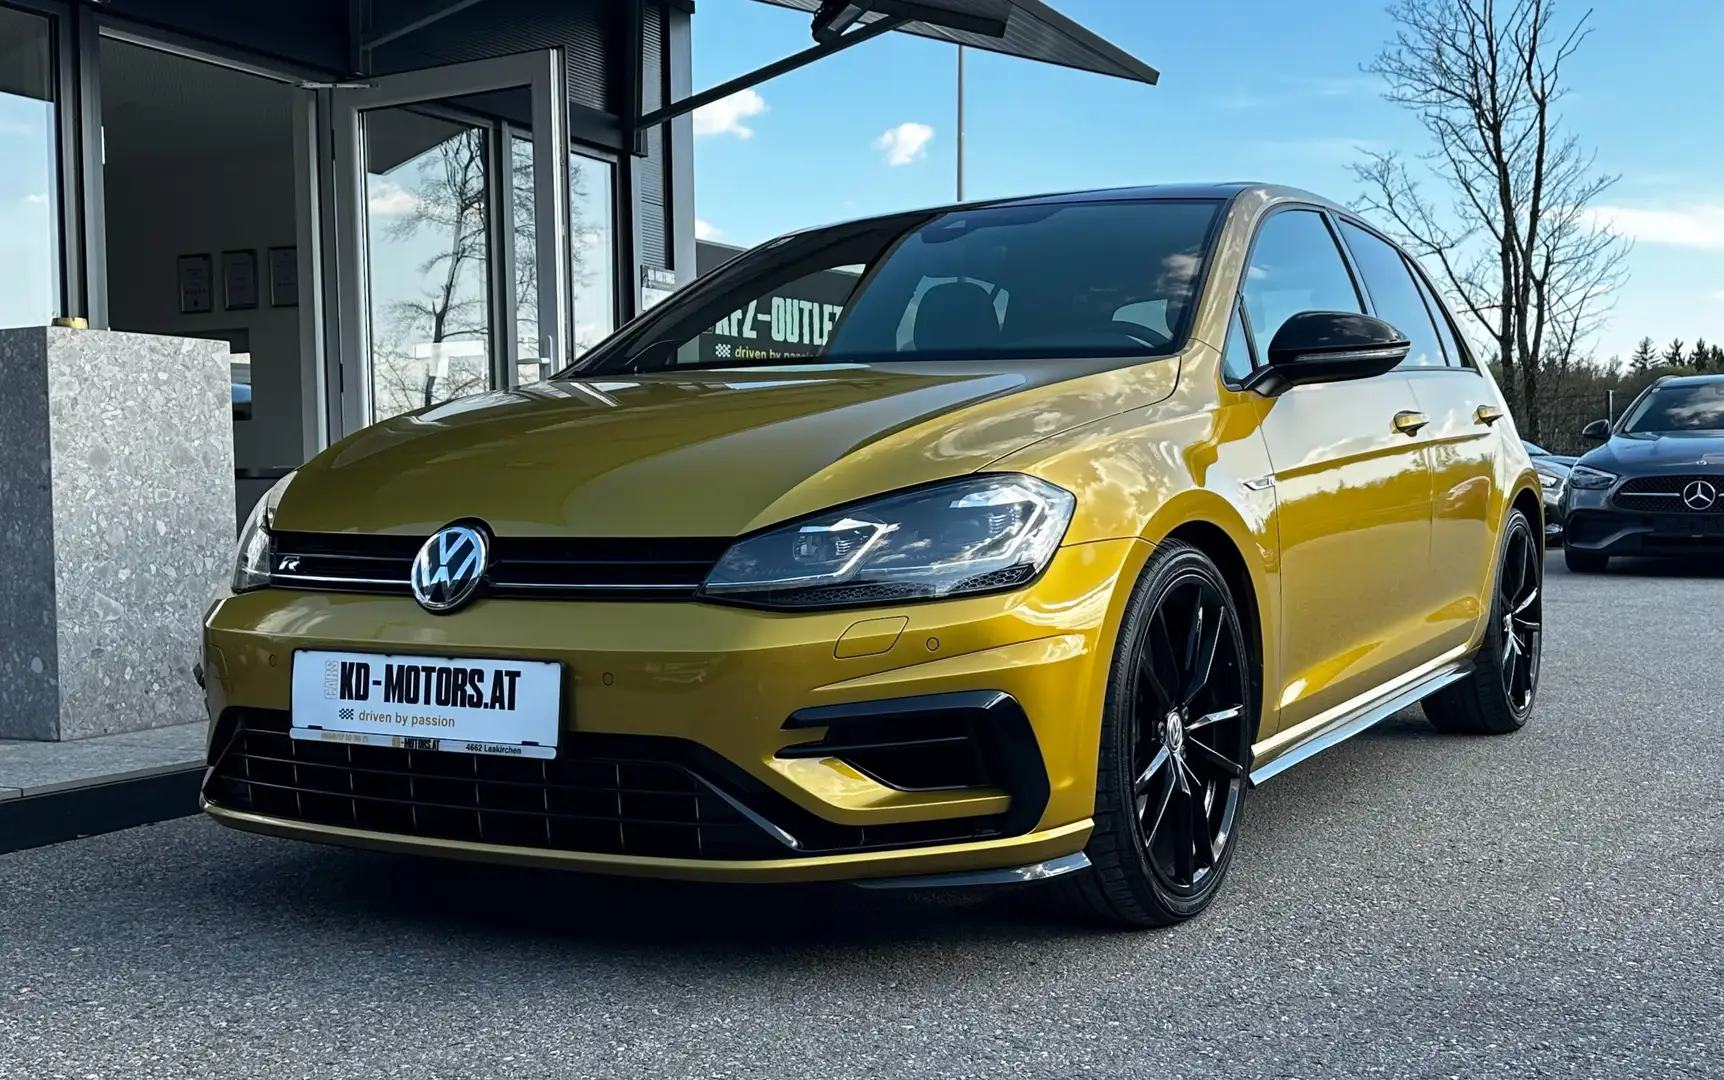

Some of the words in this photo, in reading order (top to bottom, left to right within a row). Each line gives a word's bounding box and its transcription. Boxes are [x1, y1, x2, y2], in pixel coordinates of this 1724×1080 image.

[735, 346, 767, 359] driven
[324, 660, 339, 700] CARS
[340, 661, 521, 711] KD-MOTORS.AT
[359, 710, 392, 723] driven
[395, 712, 408, 727] by
[411, 715, 455, 728] passion
[465, 743, 482, 752] 4662
[483, 744, 522, 755] Laakirchen
